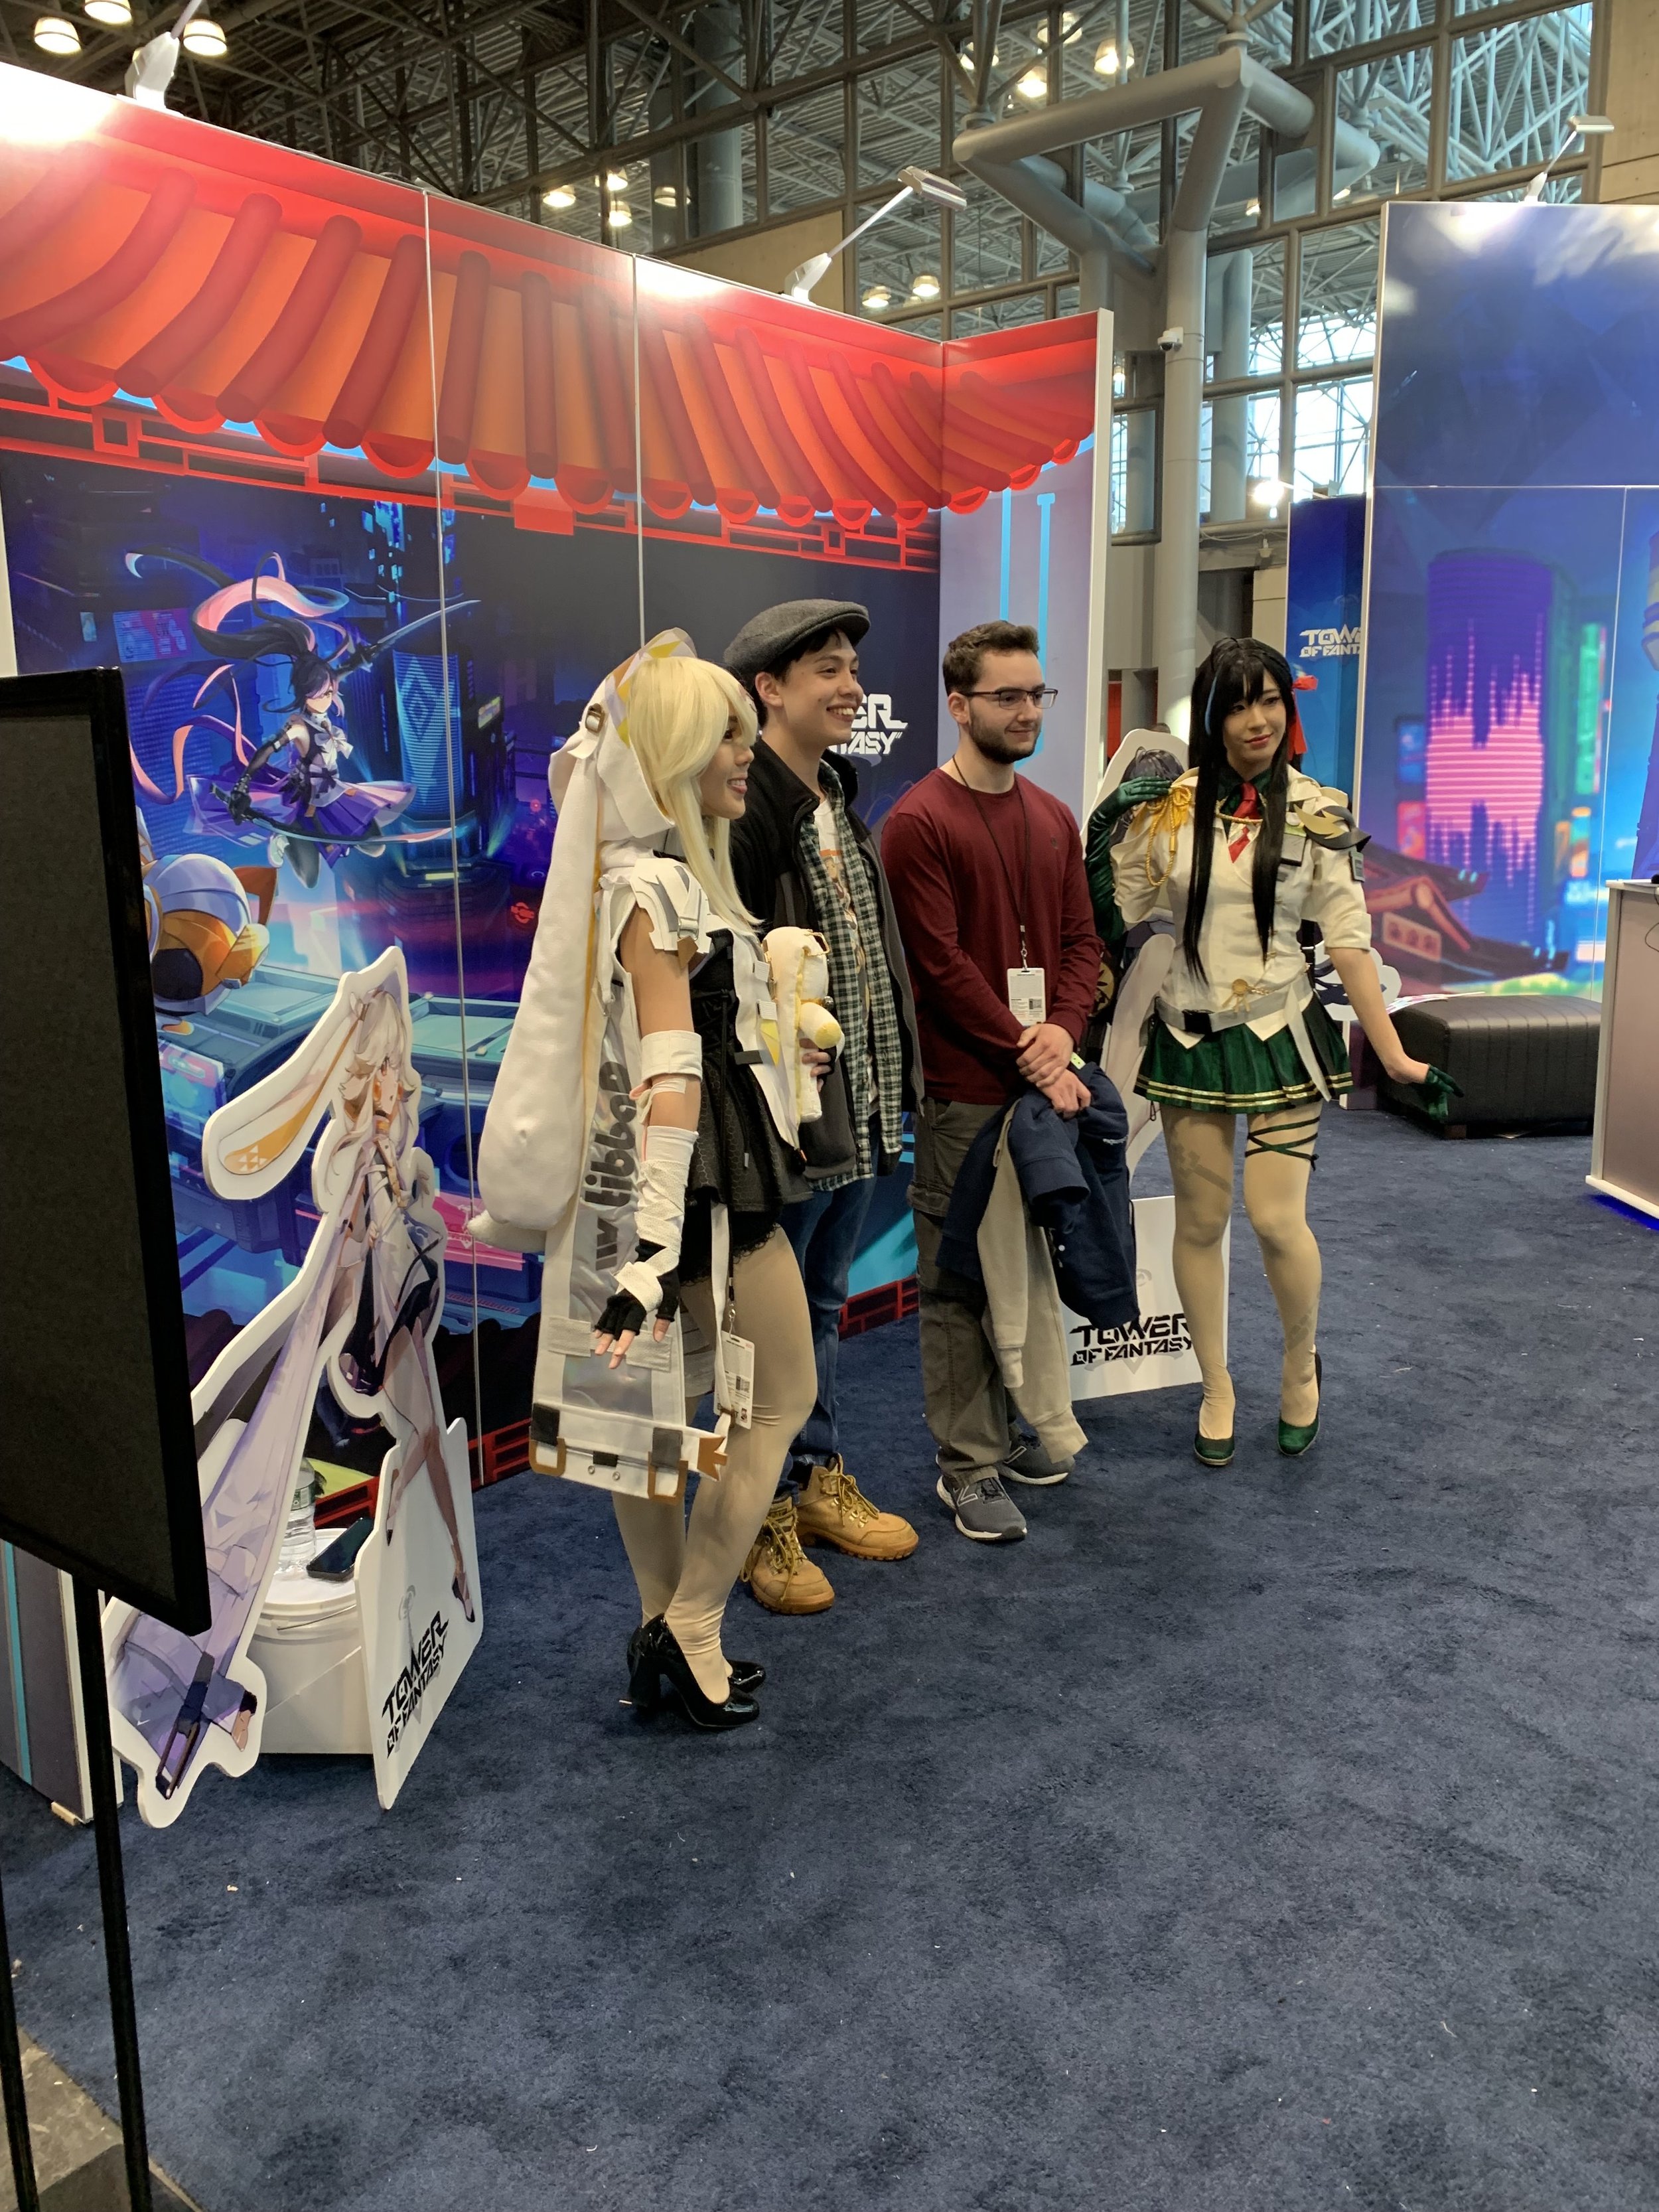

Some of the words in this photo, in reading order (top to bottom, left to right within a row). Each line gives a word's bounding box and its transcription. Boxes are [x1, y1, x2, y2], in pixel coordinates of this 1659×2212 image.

[1299, 624, 1361, 645] TOW
[1299, 646, 1322, 658] OF
[1323, 643, 1360, 656] FANT
[1070, 1348, 1102, 1366] OF
[382, 1610, 449, 1725] TOWER
[401, 1630, 448, 1725] FANTASY
